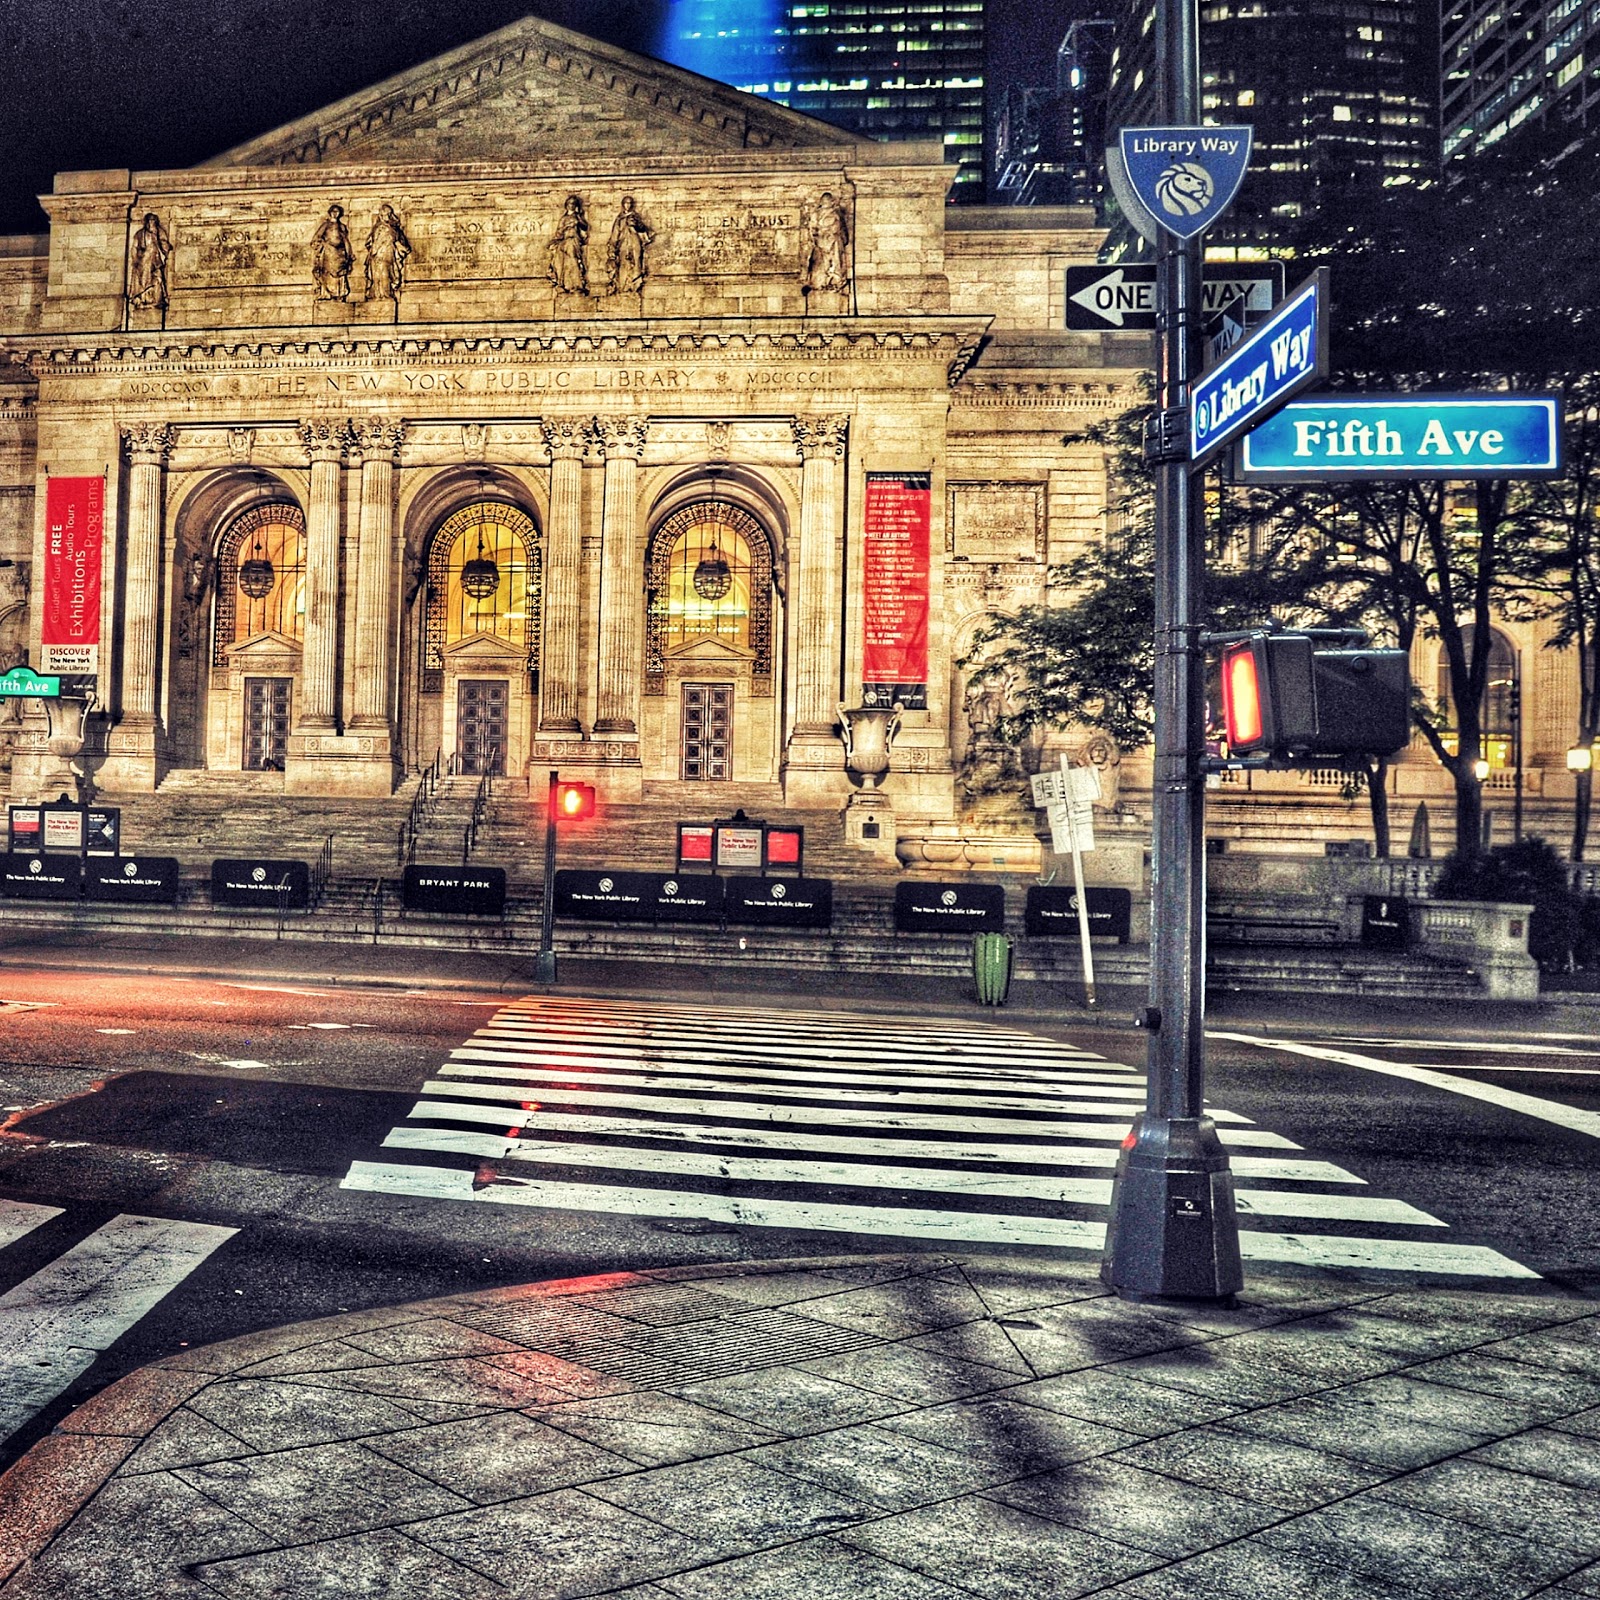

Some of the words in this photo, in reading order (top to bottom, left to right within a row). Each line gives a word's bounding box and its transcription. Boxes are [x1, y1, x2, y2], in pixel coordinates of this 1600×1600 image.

[1134, 138, 1196, 156] Library
[1201, 138, 1240, 155] Way
[1096, 285, 1152, 310] ONE
[1202, 283, 1256, 308] WAY
[262, 376, 306, 394] THE
[325, 374, 383, 392] NEW
[404, 372, 466, 390] YORK
[485, 372, 572, 390] PUBLIC
[593, 370, 698, 388] LIBRARY
[1209, 360, 1268, 432] Library
[1270, 323, 1312, 381] Way
[1292, 419, 1404, 457] Fifth
[1416, 418, 1504, 456] Ave
[66, 504, 75, 530] Tours
[84, 479, 100, 548] Programs
[51, 524, 62, 555] FREE
[66, 532, 74, 562] Audio
[52, 558, 62, 584] Tours
[51, 588, 61, 624] Guided
[70, 550, 86, 637] Exhibitions
[25, 680, 49, 692] Ave
[419, 879, 459, 887] BRYANT
[1093, 912, 1112, 920] Library
